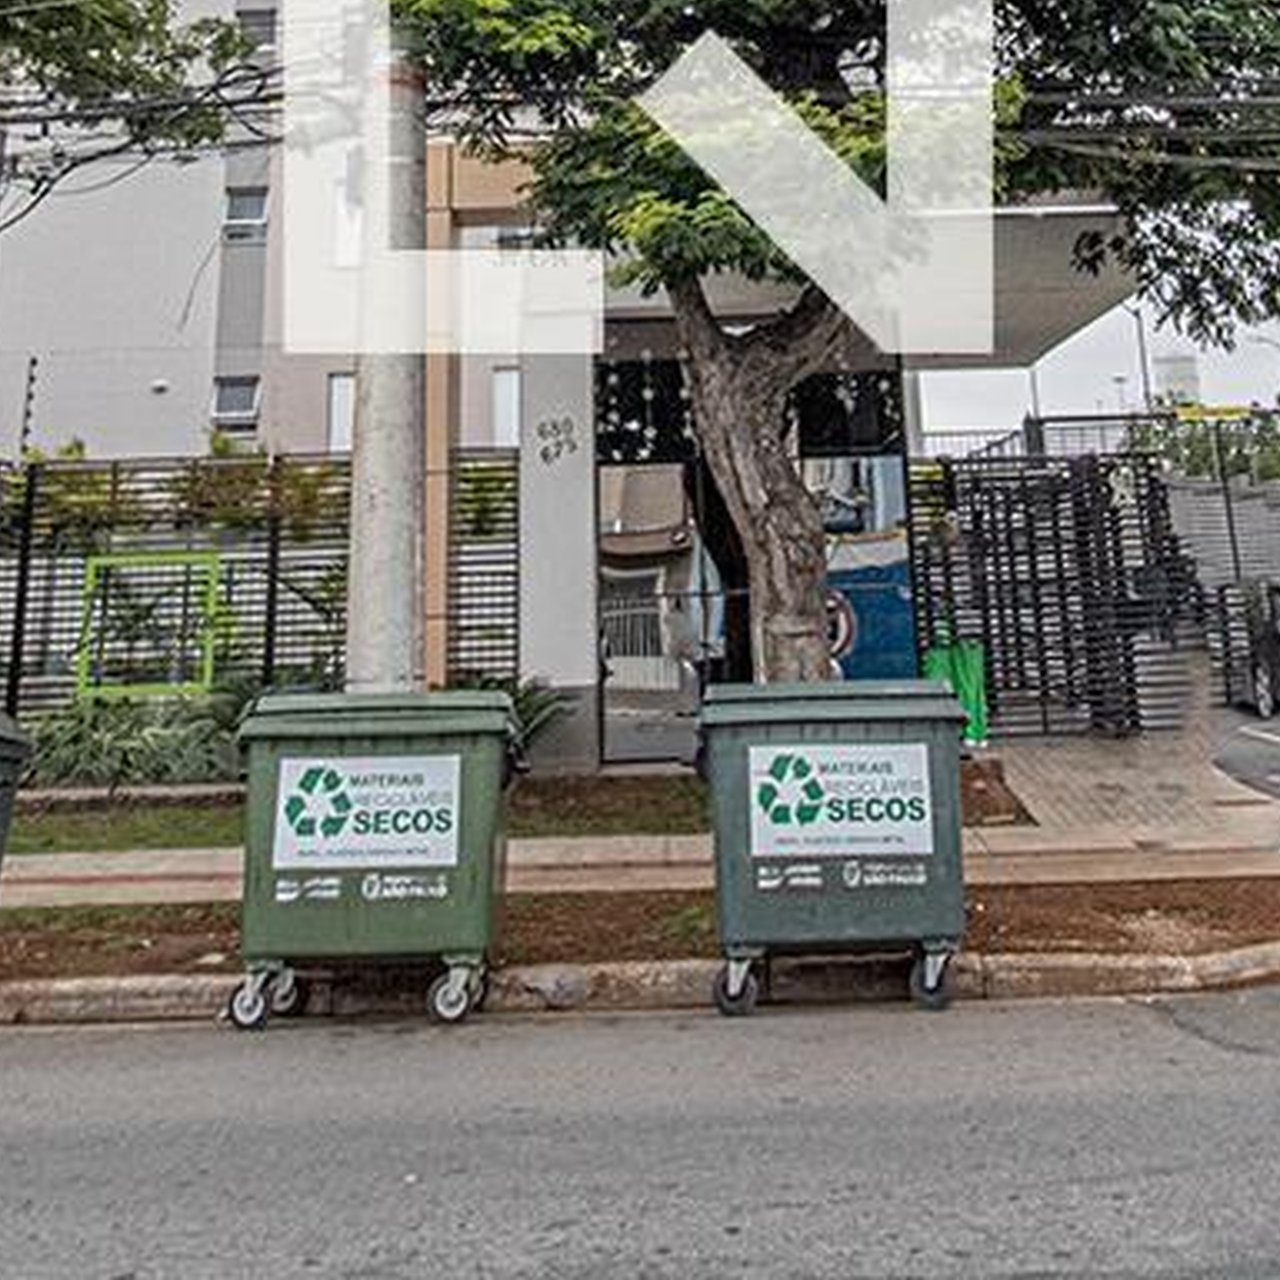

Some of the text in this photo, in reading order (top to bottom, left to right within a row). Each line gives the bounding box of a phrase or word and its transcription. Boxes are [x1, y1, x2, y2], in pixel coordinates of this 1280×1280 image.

[348, 773, 424, 787] MATERIAIS
[827, 797, 926, 821] SECOS
[353, 809, 453, 835] SECOS
